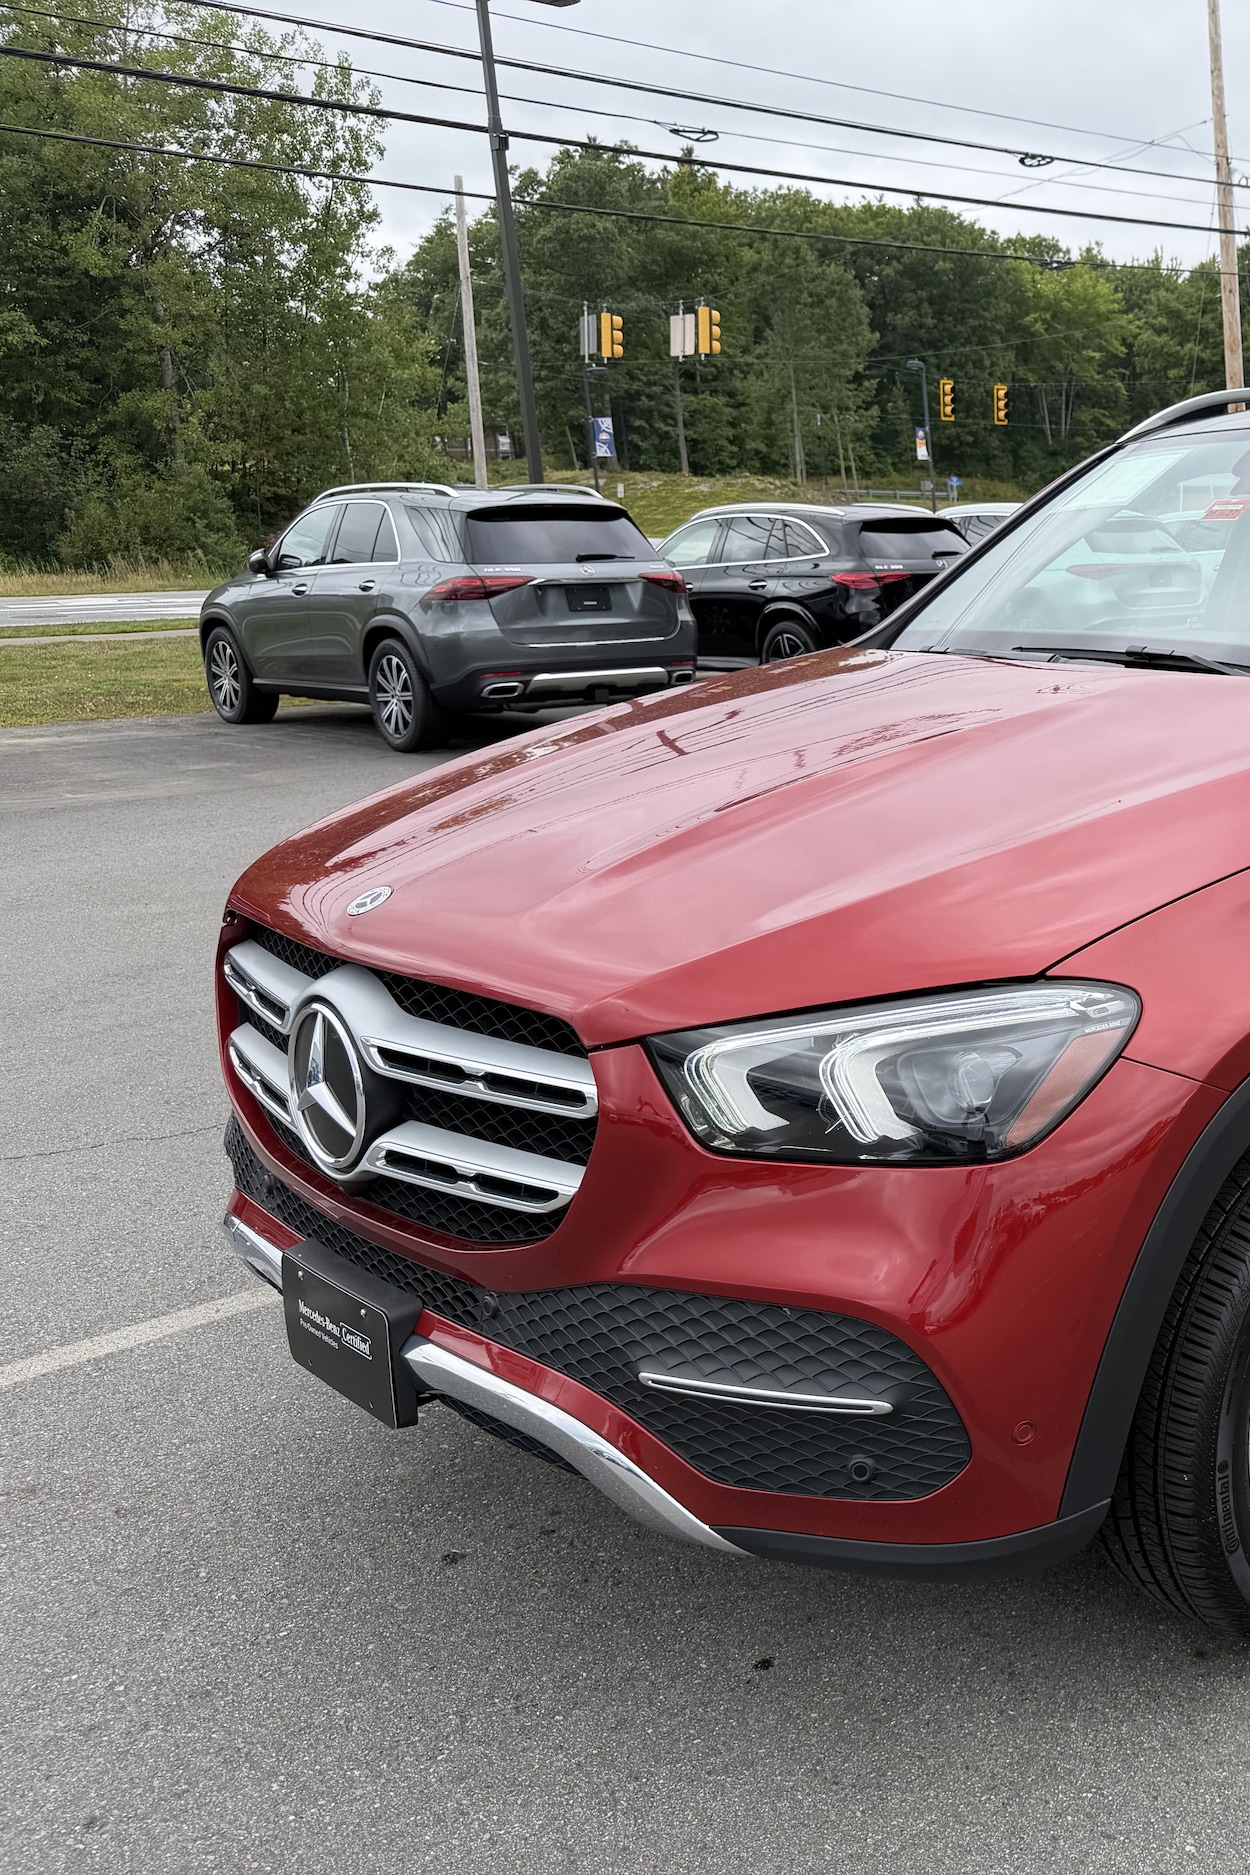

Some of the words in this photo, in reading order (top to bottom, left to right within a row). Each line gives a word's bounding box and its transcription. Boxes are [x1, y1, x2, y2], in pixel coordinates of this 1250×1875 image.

[298, 1298, 341, 1337] Mercedes-Benz
[342, 1327, 370, 1355] Certified
[1217, 1473, 1240, 1554] Continental
